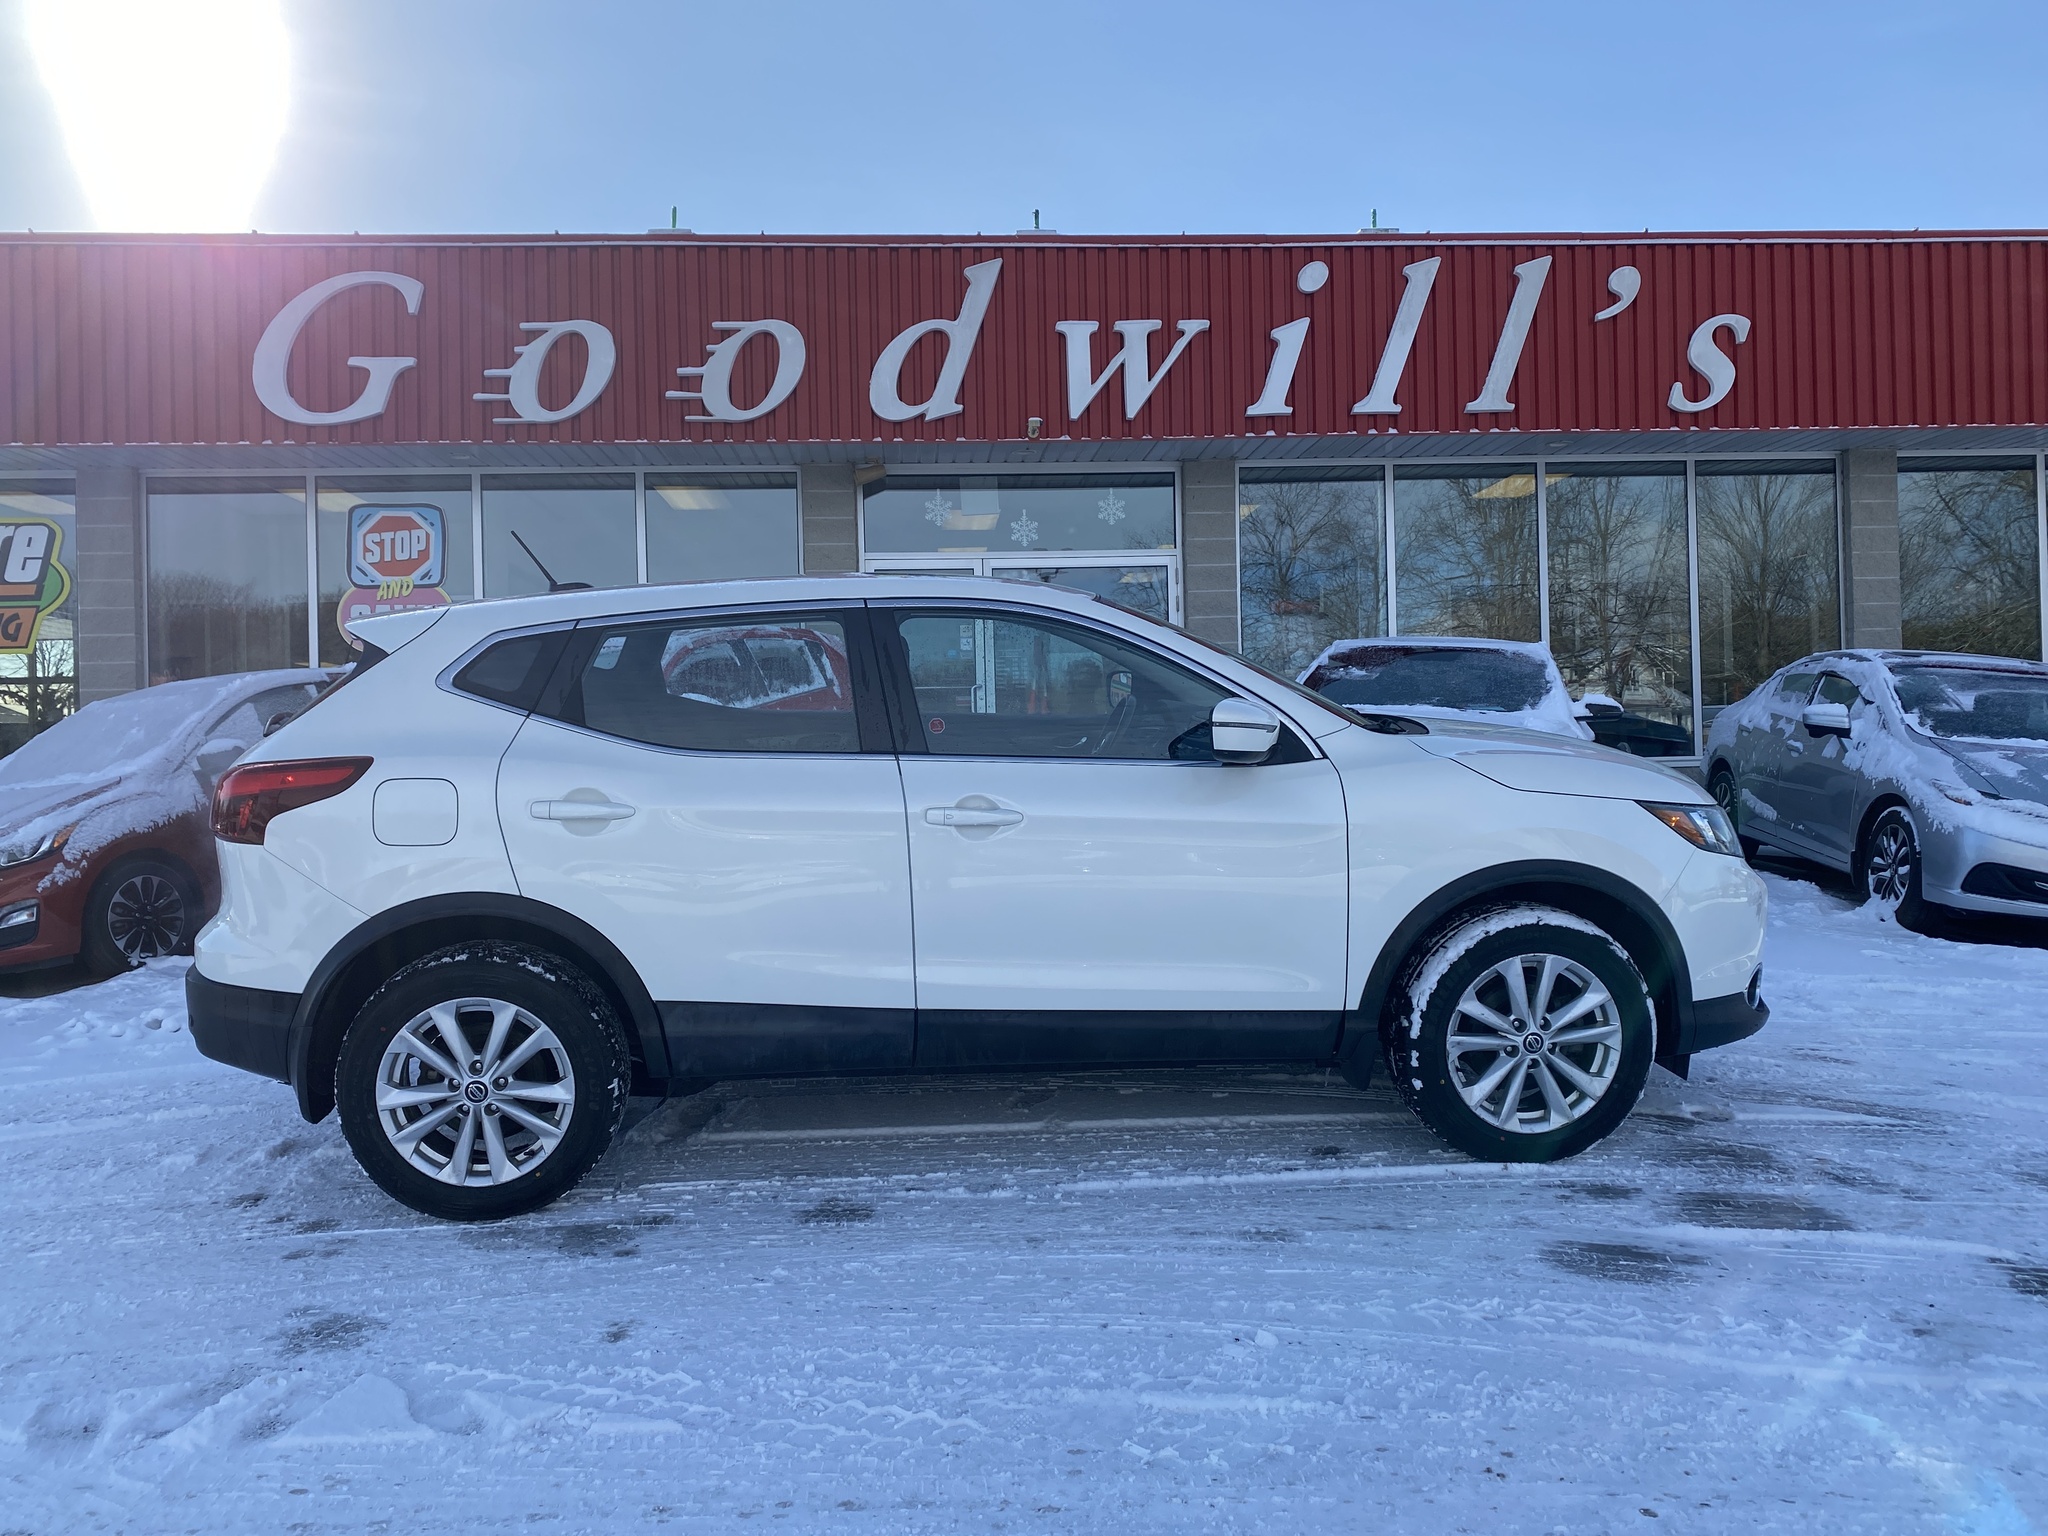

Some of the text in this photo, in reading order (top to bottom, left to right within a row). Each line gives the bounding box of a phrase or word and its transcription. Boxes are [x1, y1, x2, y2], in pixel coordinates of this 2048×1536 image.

[252, 256, 1752, 426] Goodwill's
[364, 528, 427, 564] STOP
[376, 577, 414, 601] AND
[0, 612, 23, 642] G
